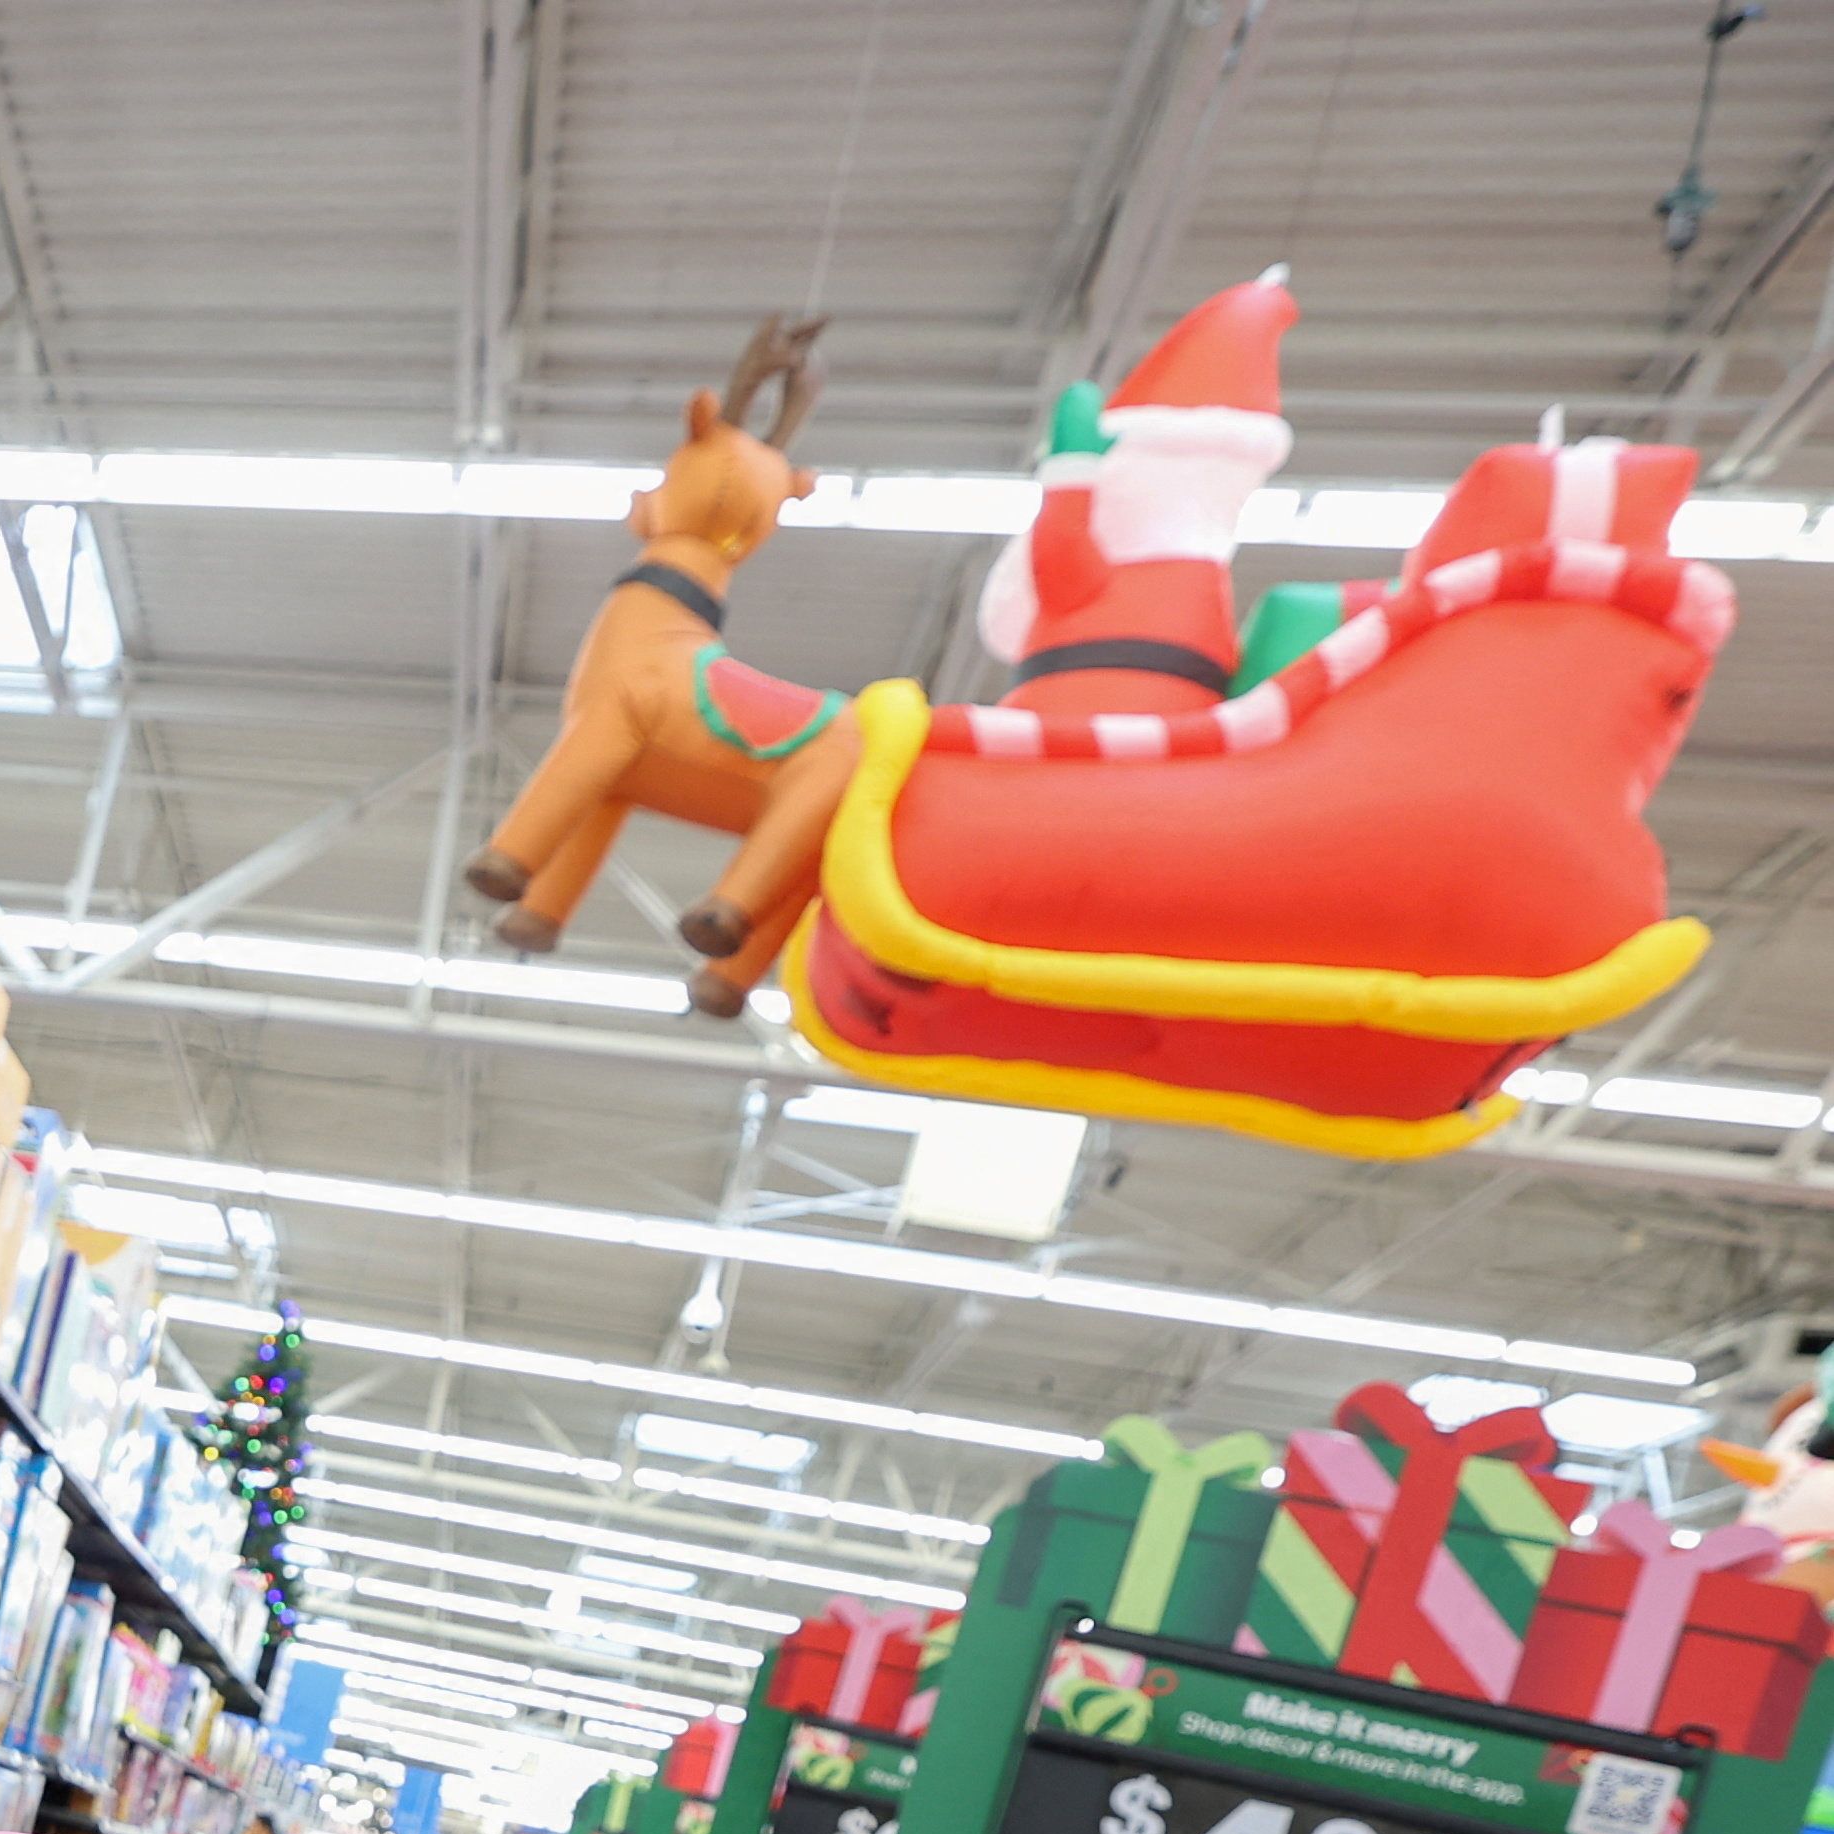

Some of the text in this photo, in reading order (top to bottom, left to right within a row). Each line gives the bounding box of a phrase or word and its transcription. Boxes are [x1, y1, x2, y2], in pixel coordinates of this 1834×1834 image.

[1178, 1710, 1244, 1746] Shop
[1332, 1748, 1402, 1779] more
[1242, 1690, 1480, 1769] Make it merry
